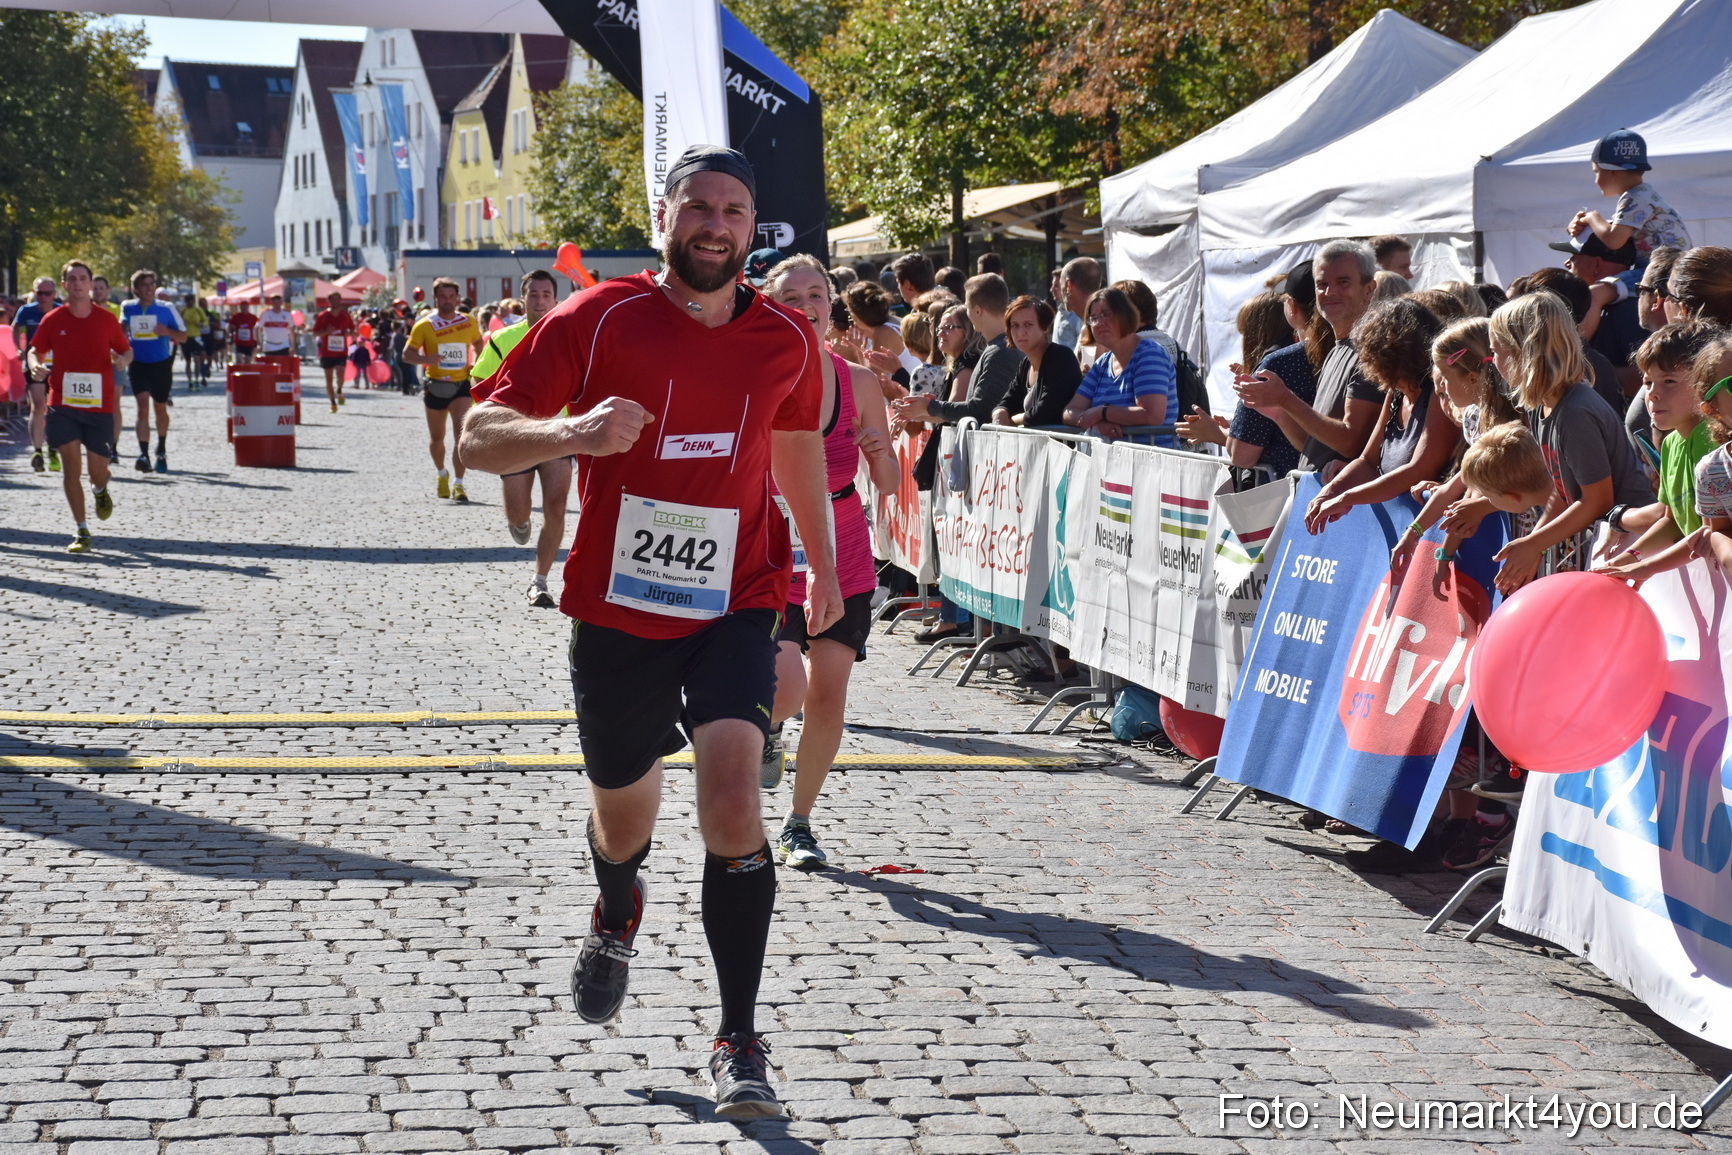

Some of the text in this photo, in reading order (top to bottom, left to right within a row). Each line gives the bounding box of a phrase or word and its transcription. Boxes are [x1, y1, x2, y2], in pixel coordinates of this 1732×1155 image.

[597, 0, 640, 30] PAR
[1613, 147, 1640, 156] YORK
[1617, 140, 1638, 149] NEW
[138, 322, 149, 330] 33
[442, 350, 463, 359] 2403
[71, 382, 93, 394] 184
[681, 440, 715, 452] DEHN
[654, 510, 707, 529] BOCK
[631, 529, 718, 572] 2442
[636, 567, 696, 583] PARTL Neumarkt
[1291, 554, 1338, 584] STORE
[643, 584, 692, 605] Jürgen
[1273, 611, 1328, 645] ONLINE
[1187, 680, 1213, 694] markt
[1254, 668, 1312, 704] MOBILE
